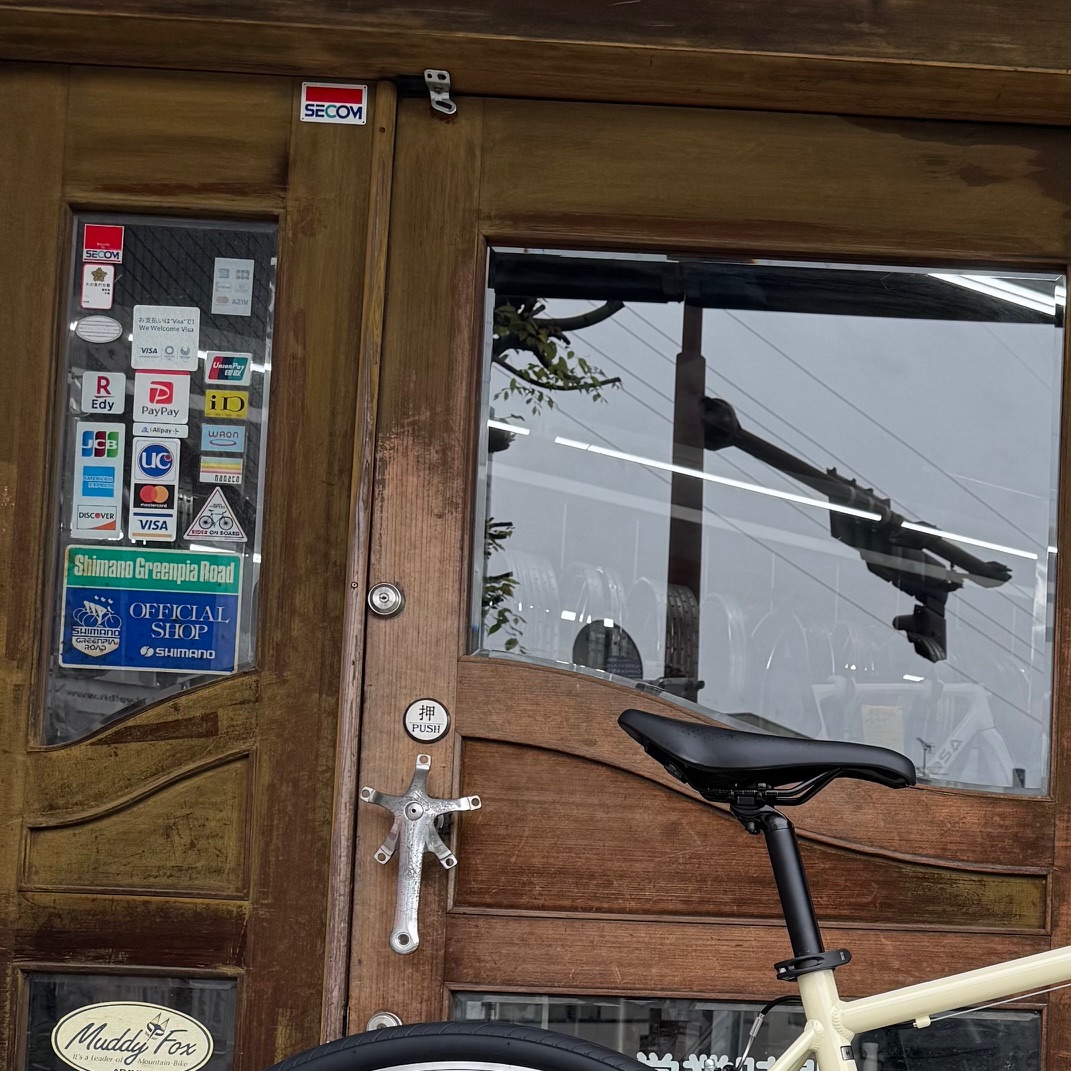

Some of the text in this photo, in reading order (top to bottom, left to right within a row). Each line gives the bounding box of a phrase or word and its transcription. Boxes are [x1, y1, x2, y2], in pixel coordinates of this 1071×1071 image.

[305, 103, 363, 120] SECOM
[86, 250, 119, 259] SECOM
[212, 361, 246, 371] UnionPay
[91, 399, 115, 411] Edy
[209, 394, 245, 413] iD
[141, 406, 180, 418] PayPay
[139, 519, 168, 531] VISA
[74, 554, 235, 584] Shimano Greenpia Road
[129, 602, 231, 623] OFFICIAL
[72, 627, 121, 636] SHIMANO
[151, 621, 208, 640] SHOP
[155, 647, 216, 659] SHIMANO
[418, 704, 436, 722] 押
[412, 723, 441, 734] PUSH
[64, 1022, 197, 1066] Muddy Fox
